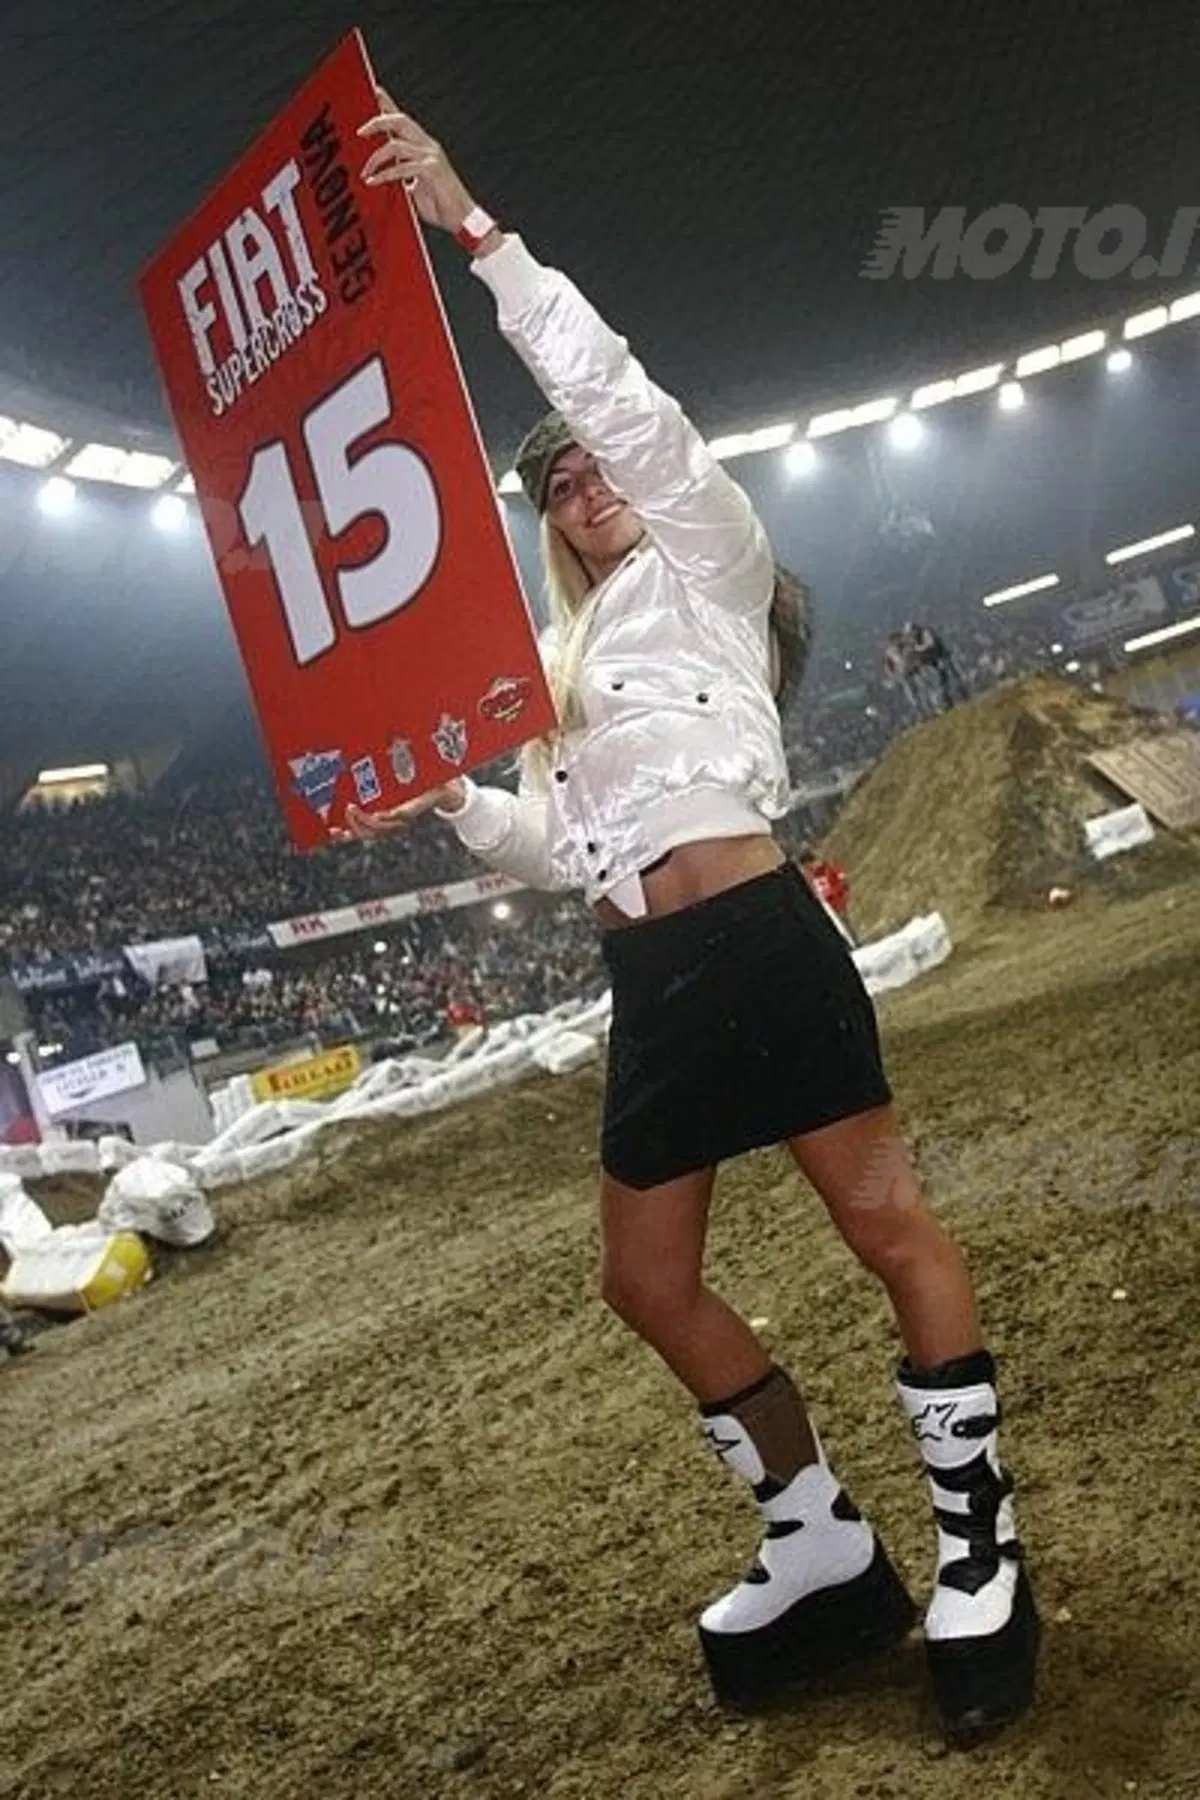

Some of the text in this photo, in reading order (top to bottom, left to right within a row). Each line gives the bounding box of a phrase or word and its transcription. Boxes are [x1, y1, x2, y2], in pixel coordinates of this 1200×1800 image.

[178, 158, 318, 376] FIAT
[301, 103, 377, 304] GENOVA
[206, 280, 329, 416] SUPERCROSS
[238, 353, 443, 666] 15
